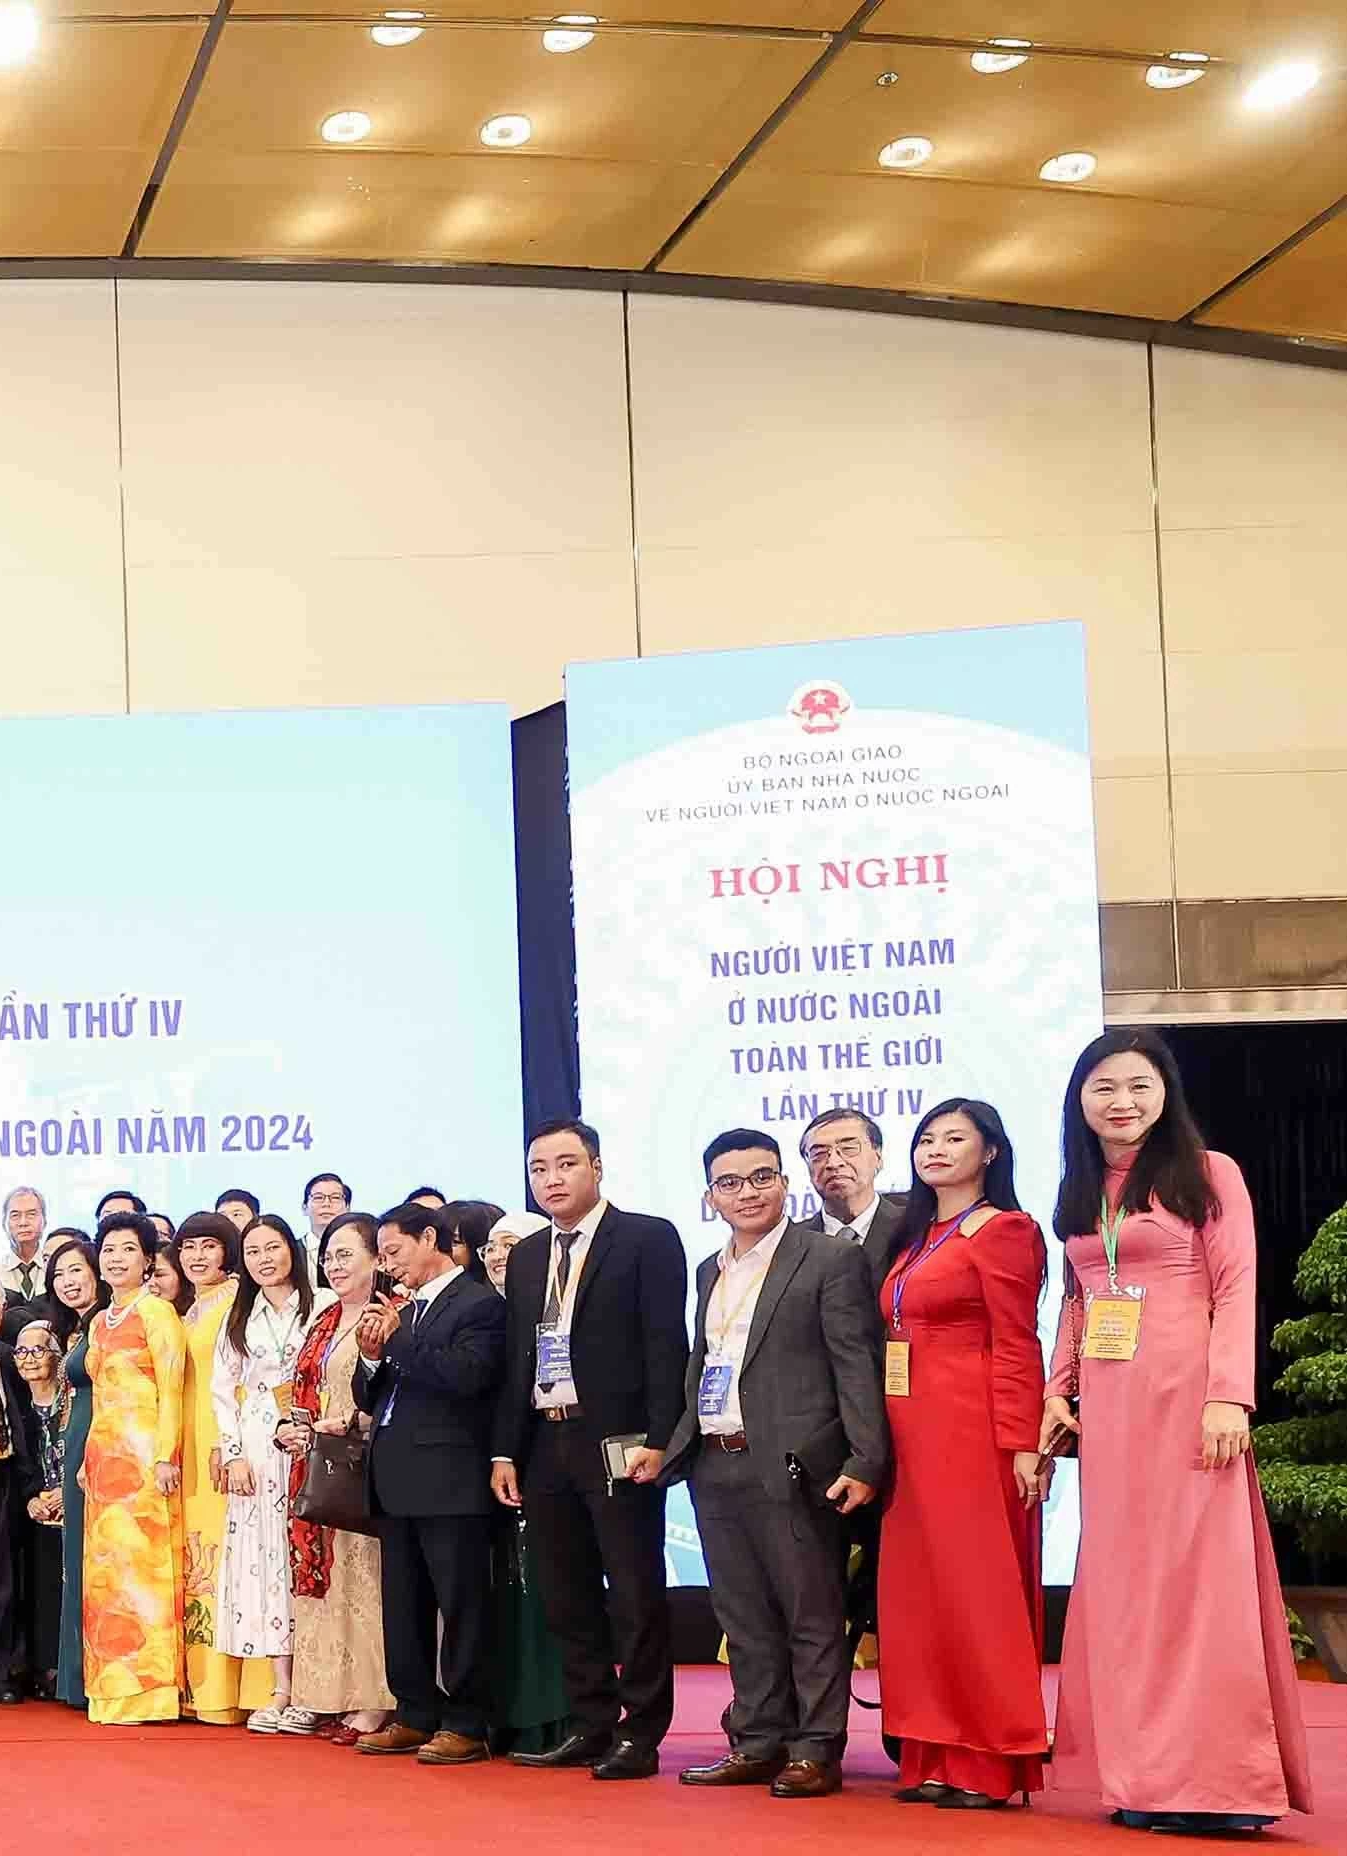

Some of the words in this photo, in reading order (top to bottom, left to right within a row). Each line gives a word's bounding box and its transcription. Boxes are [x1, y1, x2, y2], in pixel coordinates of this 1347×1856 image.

[851, 744, 903, 762] GIAO
[761, 776, 804, 792] BAN
[802, 795, 848, 812] NAM
[709, 857, 802, 905] HỘI
[819, 853, 949, 893] NGHỊ
[811, 937, 874, 977] VIỆT
[884, 938, 955, 968] NAM
[62, 992, 139, 1039] THỨ
[148, 999, 183, 1037] IV
[757, 988, 838, 1024] NƯỚC
[817, 1031, 872, 1070] THẾ
[897, 1088, 924, 1116] IV
[118, 1108, 206, 1154] NĂM
[221, 1114, 314, 1152] 2024
